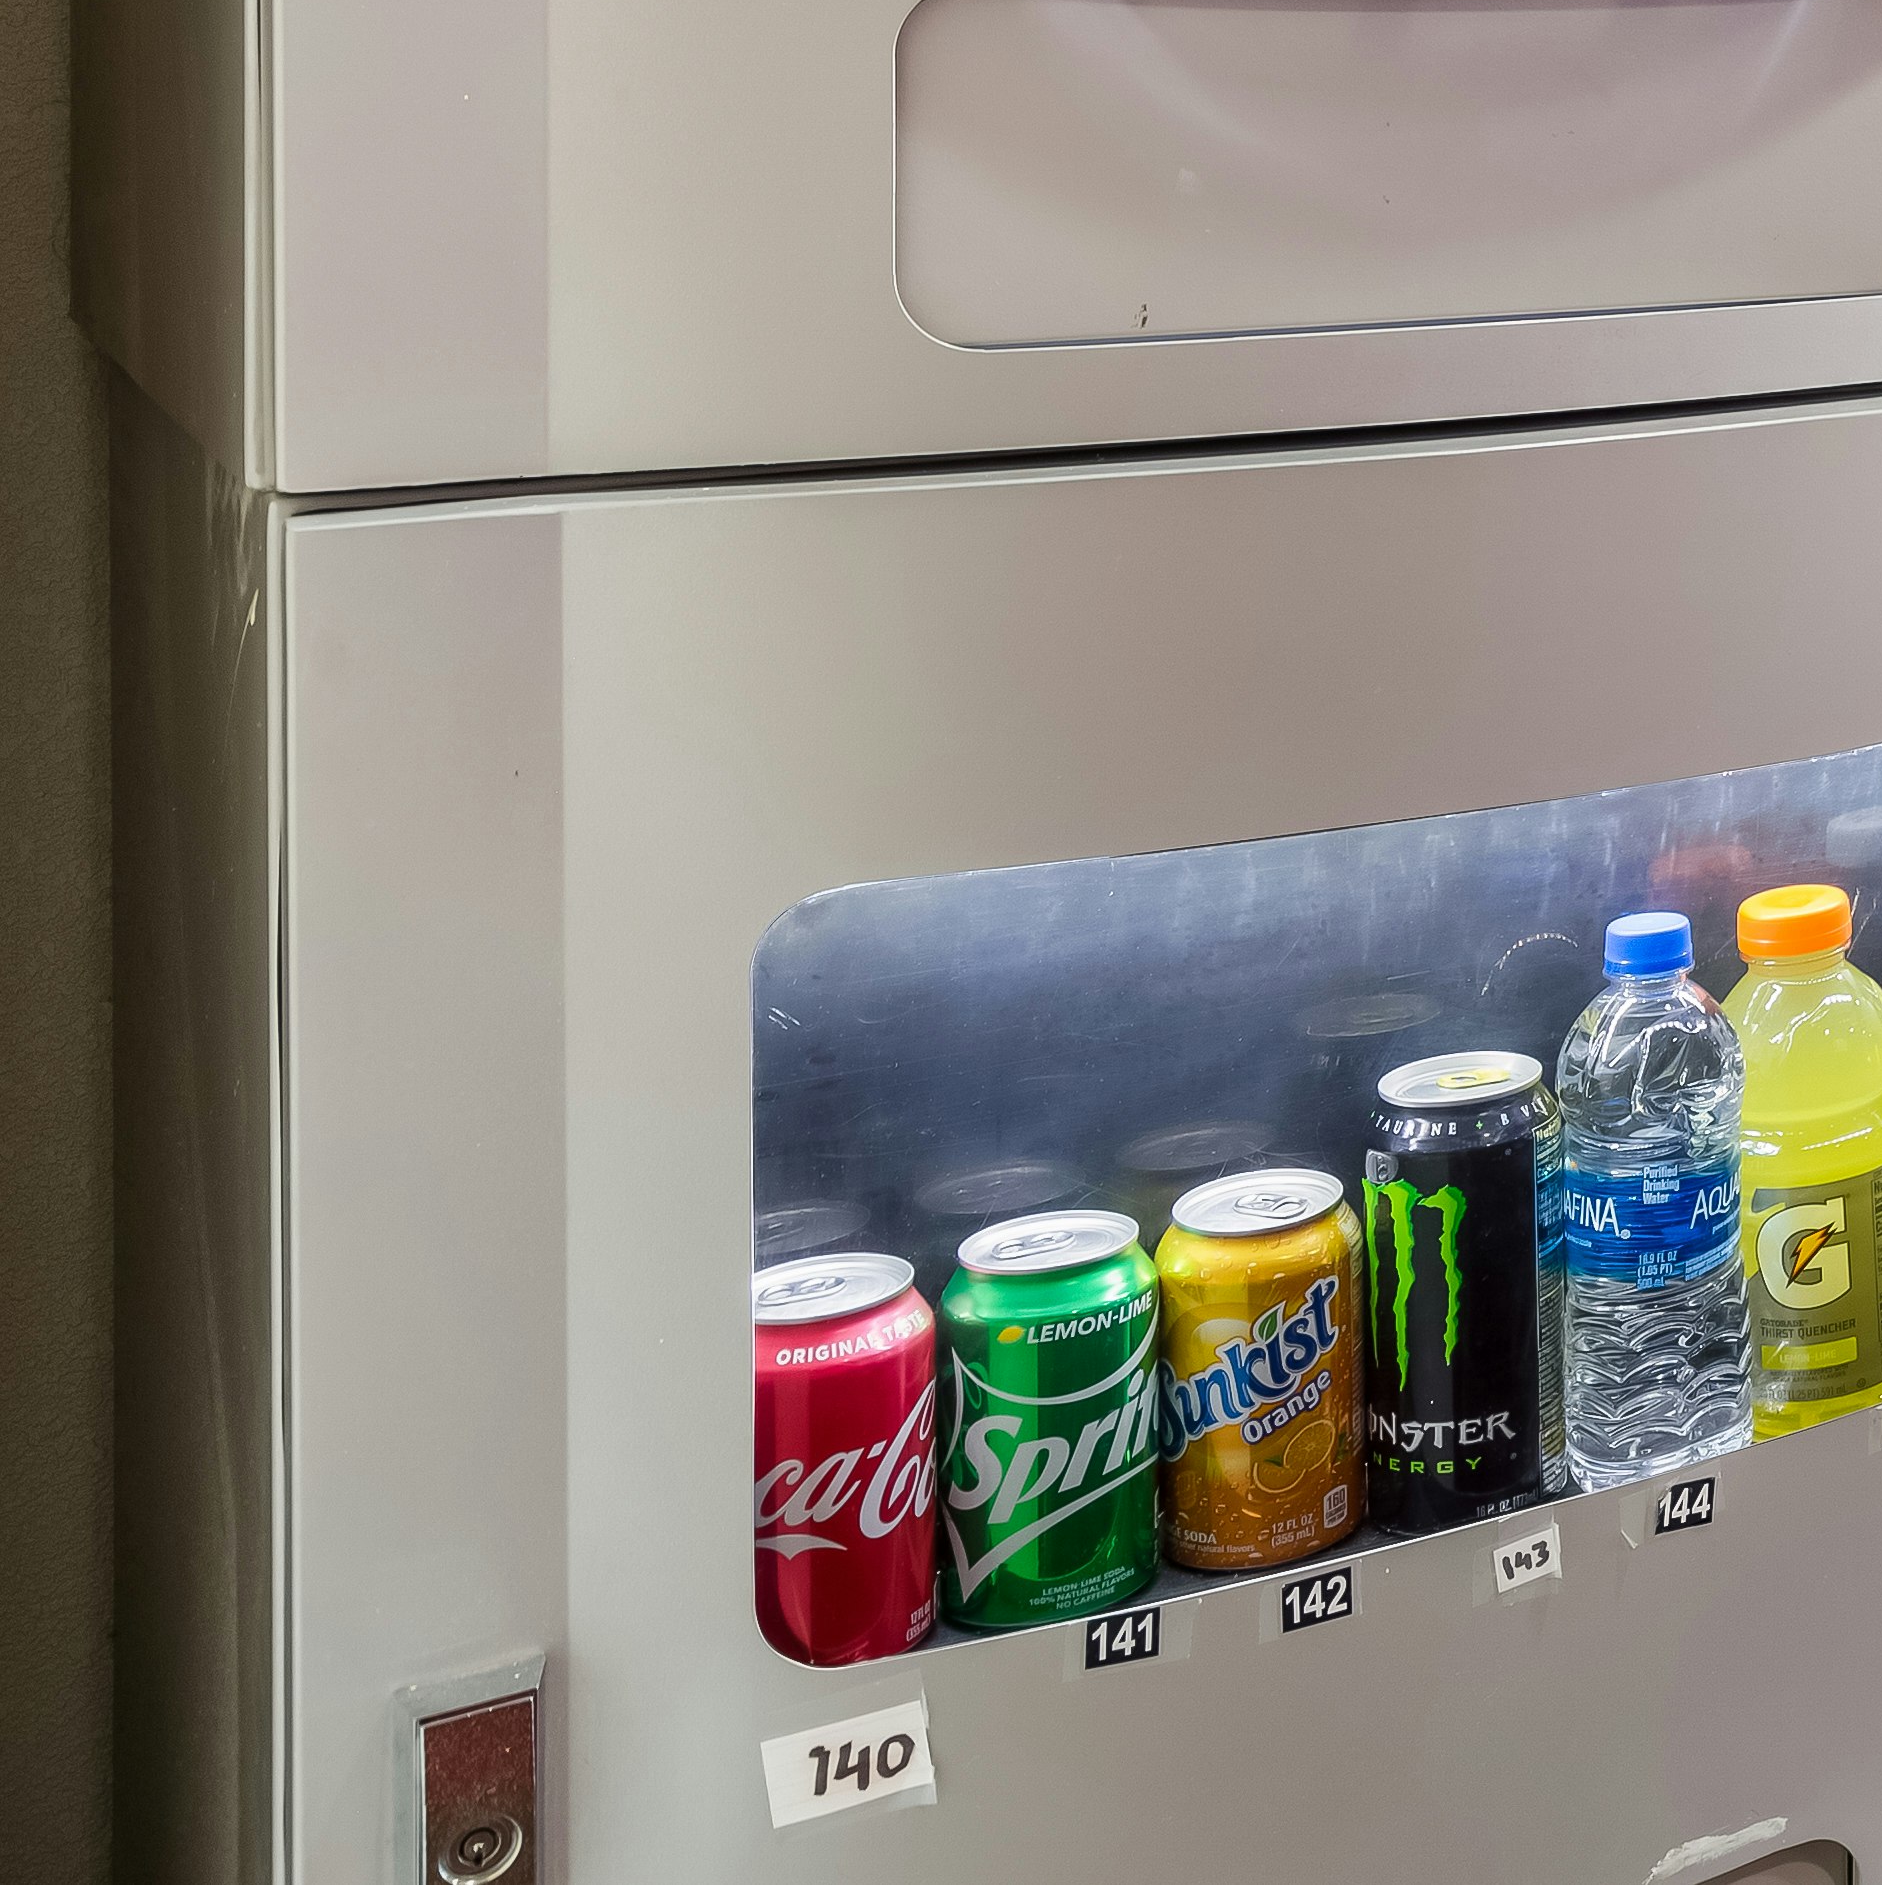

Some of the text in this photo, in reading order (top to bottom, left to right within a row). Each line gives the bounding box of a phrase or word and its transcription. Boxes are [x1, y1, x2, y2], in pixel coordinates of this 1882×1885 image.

[1375, 1113, 1510, 1138] TAURINE B
[1643, 1165, 1678, 1179] Purified
[1643, 1179, 1680, 1192] Drinking
[1642, 1192, 1670, 1205] Water
[1667, 1249, 1678, 1262] OZ
[1756, 1195, 1853, 1311] G
[1025, 1289, 1154, 1346] LEMON-LIME
[1760, 1318, 1857, 1340] THIRST QUENCHER
[775, 1331, 878, 1368] ORIGINAL
[1157, 1275, 1340, 1463] Sunkist
[1242, 1370, 1334, 1445] Orange
[1373, 1451, 1482, 1475] NERGY
[1327, 1488, 1346, 1510] 160
[1658, 1483, 1713, 1528] 144
[1183, 1529, 1218, 1546] SODA
[1271, 1521, 1285, 1535] 12
[1286, 1517, 1299, 1531] FL
[1300, 1512, 1314, 1527] OZ
[1197, 1542, 1226, 1554] natural
[1226, 1543, 1256, 1554] flavors
[1501, 1541, 1552, 1580] 143
[1056, 1599, 1072, 1611] NO
[1284, 1573, 1350, 1620] 142
[1091, 1611, 1155, 1662] 141
[808, 1732, 916, 1799] 140
